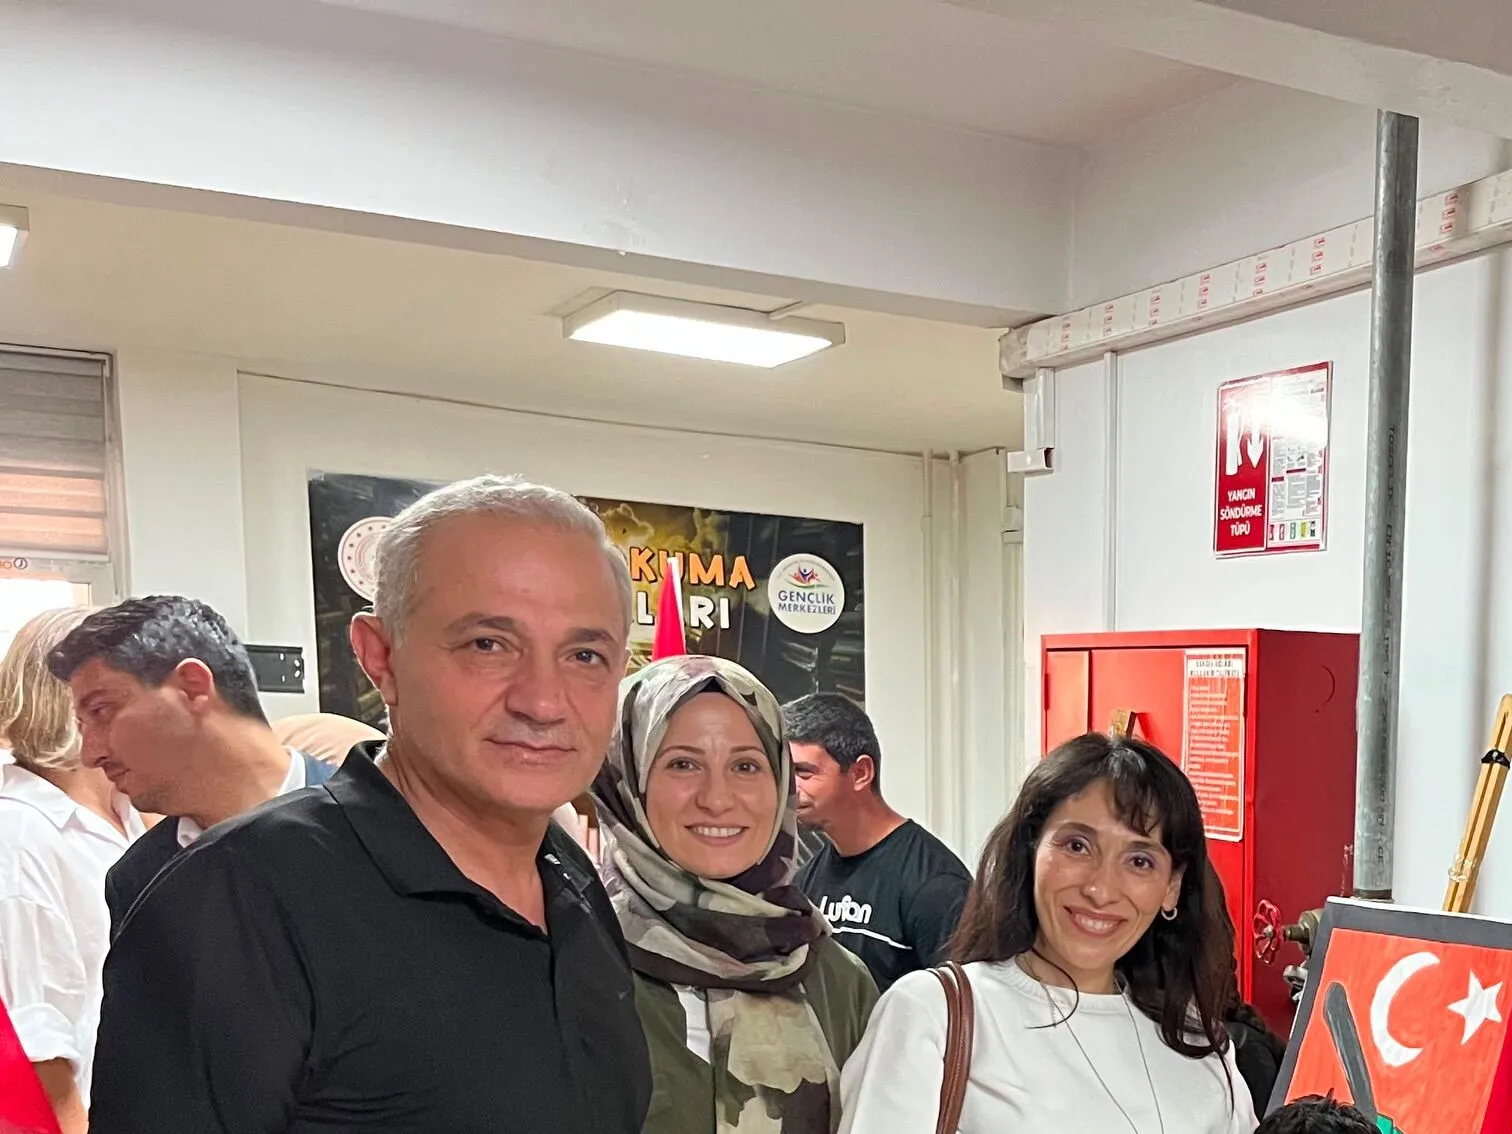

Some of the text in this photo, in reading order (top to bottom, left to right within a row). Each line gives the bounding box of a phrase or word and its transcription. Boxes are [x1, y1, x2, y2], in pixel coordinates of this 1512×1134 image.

[1227, 488, 1256, 502] YANGIN
[1220, 503, 1263, 520] SÖNDÜRME
[1230, 520, 1251, 536] TÜPÜ
[637, 592, 730, 629] LRI
